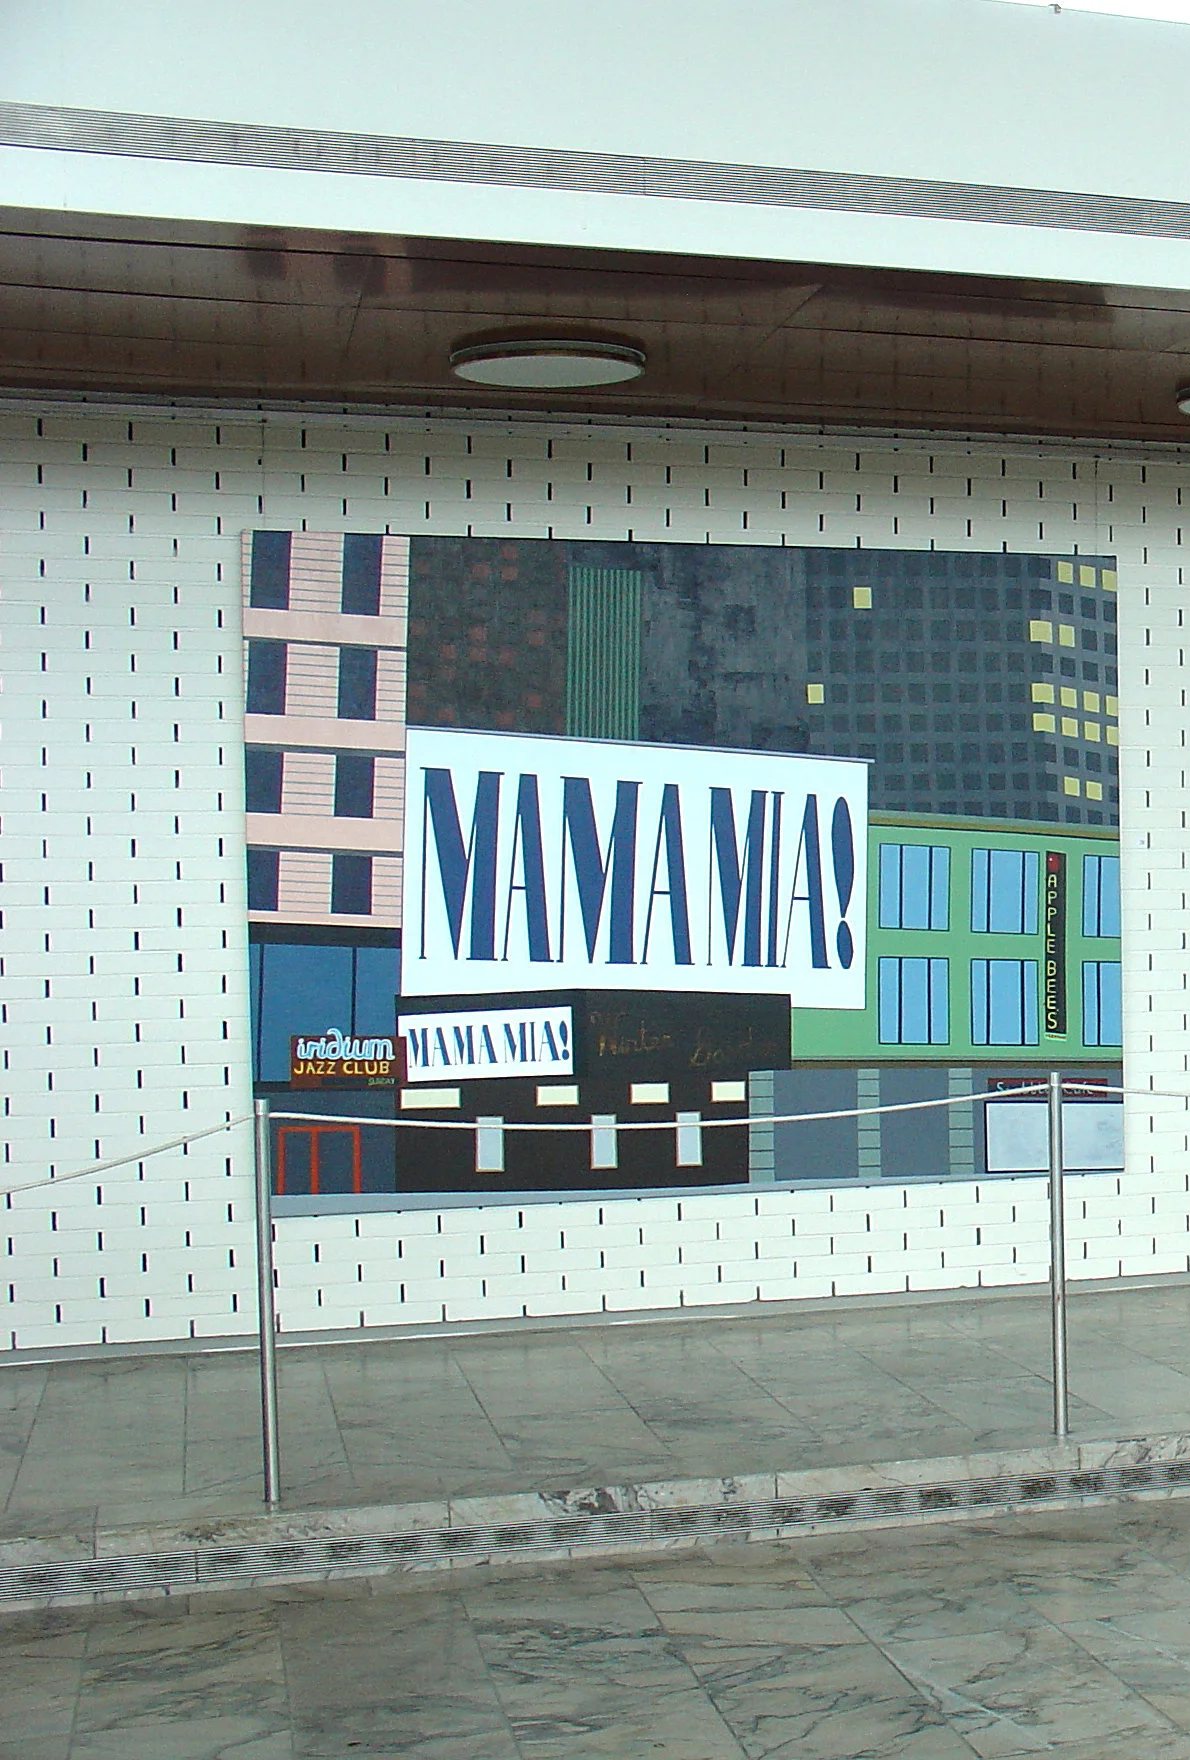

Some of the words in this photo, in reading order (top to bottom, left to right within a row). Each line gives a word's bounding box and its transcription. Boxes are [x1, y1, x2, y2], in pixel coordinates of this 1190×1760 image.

[419, 766, 695, 965] MAMA
[707, 786, 855, 970] MIA!
[296, 1028, 396, 1060] iridium
[408, 1024, 498, 1068] MAMA
[503, 1020, 570, 1063] MIA!
[293, 1061, 337, 1075] JAZZ
[342, 1061, 390, 1075] CLUB
